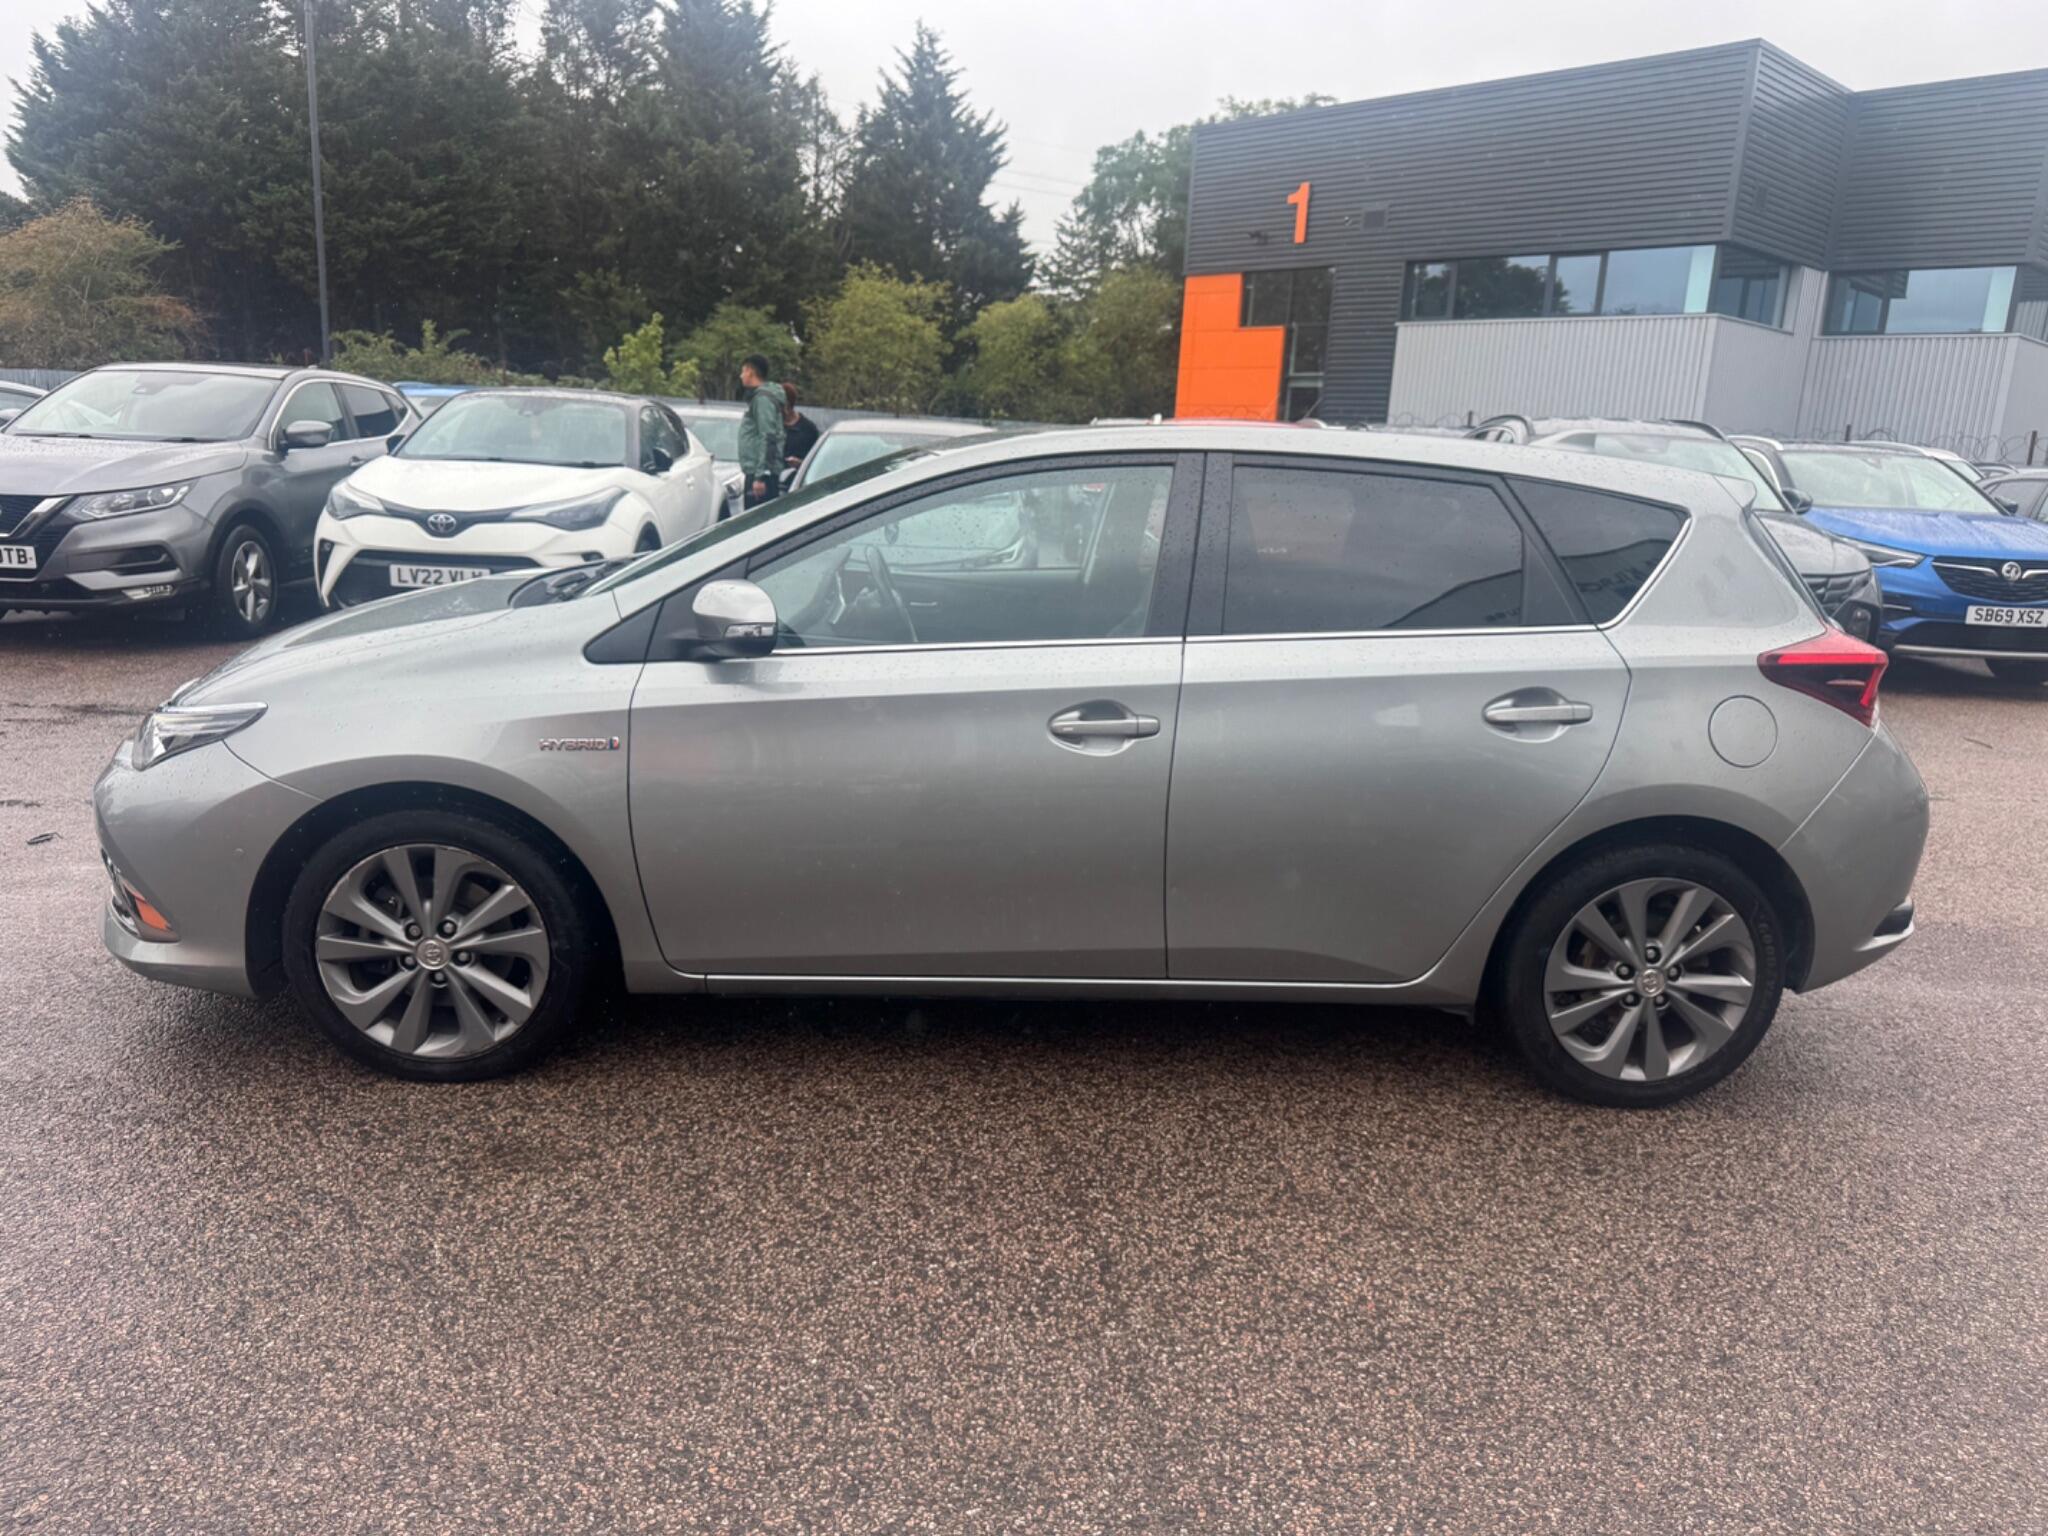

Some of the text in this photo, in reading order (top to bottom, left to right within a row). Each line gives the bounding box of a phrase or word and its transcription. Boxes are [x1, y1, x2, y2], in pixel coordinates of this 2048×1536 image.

[1287, 181, 1311, 244] 1
[397, 567, 443, 585] LV22
[1974, 607, 2044, 625] SB69 XSZ
[539, 738, 607, 751] HYBRID
